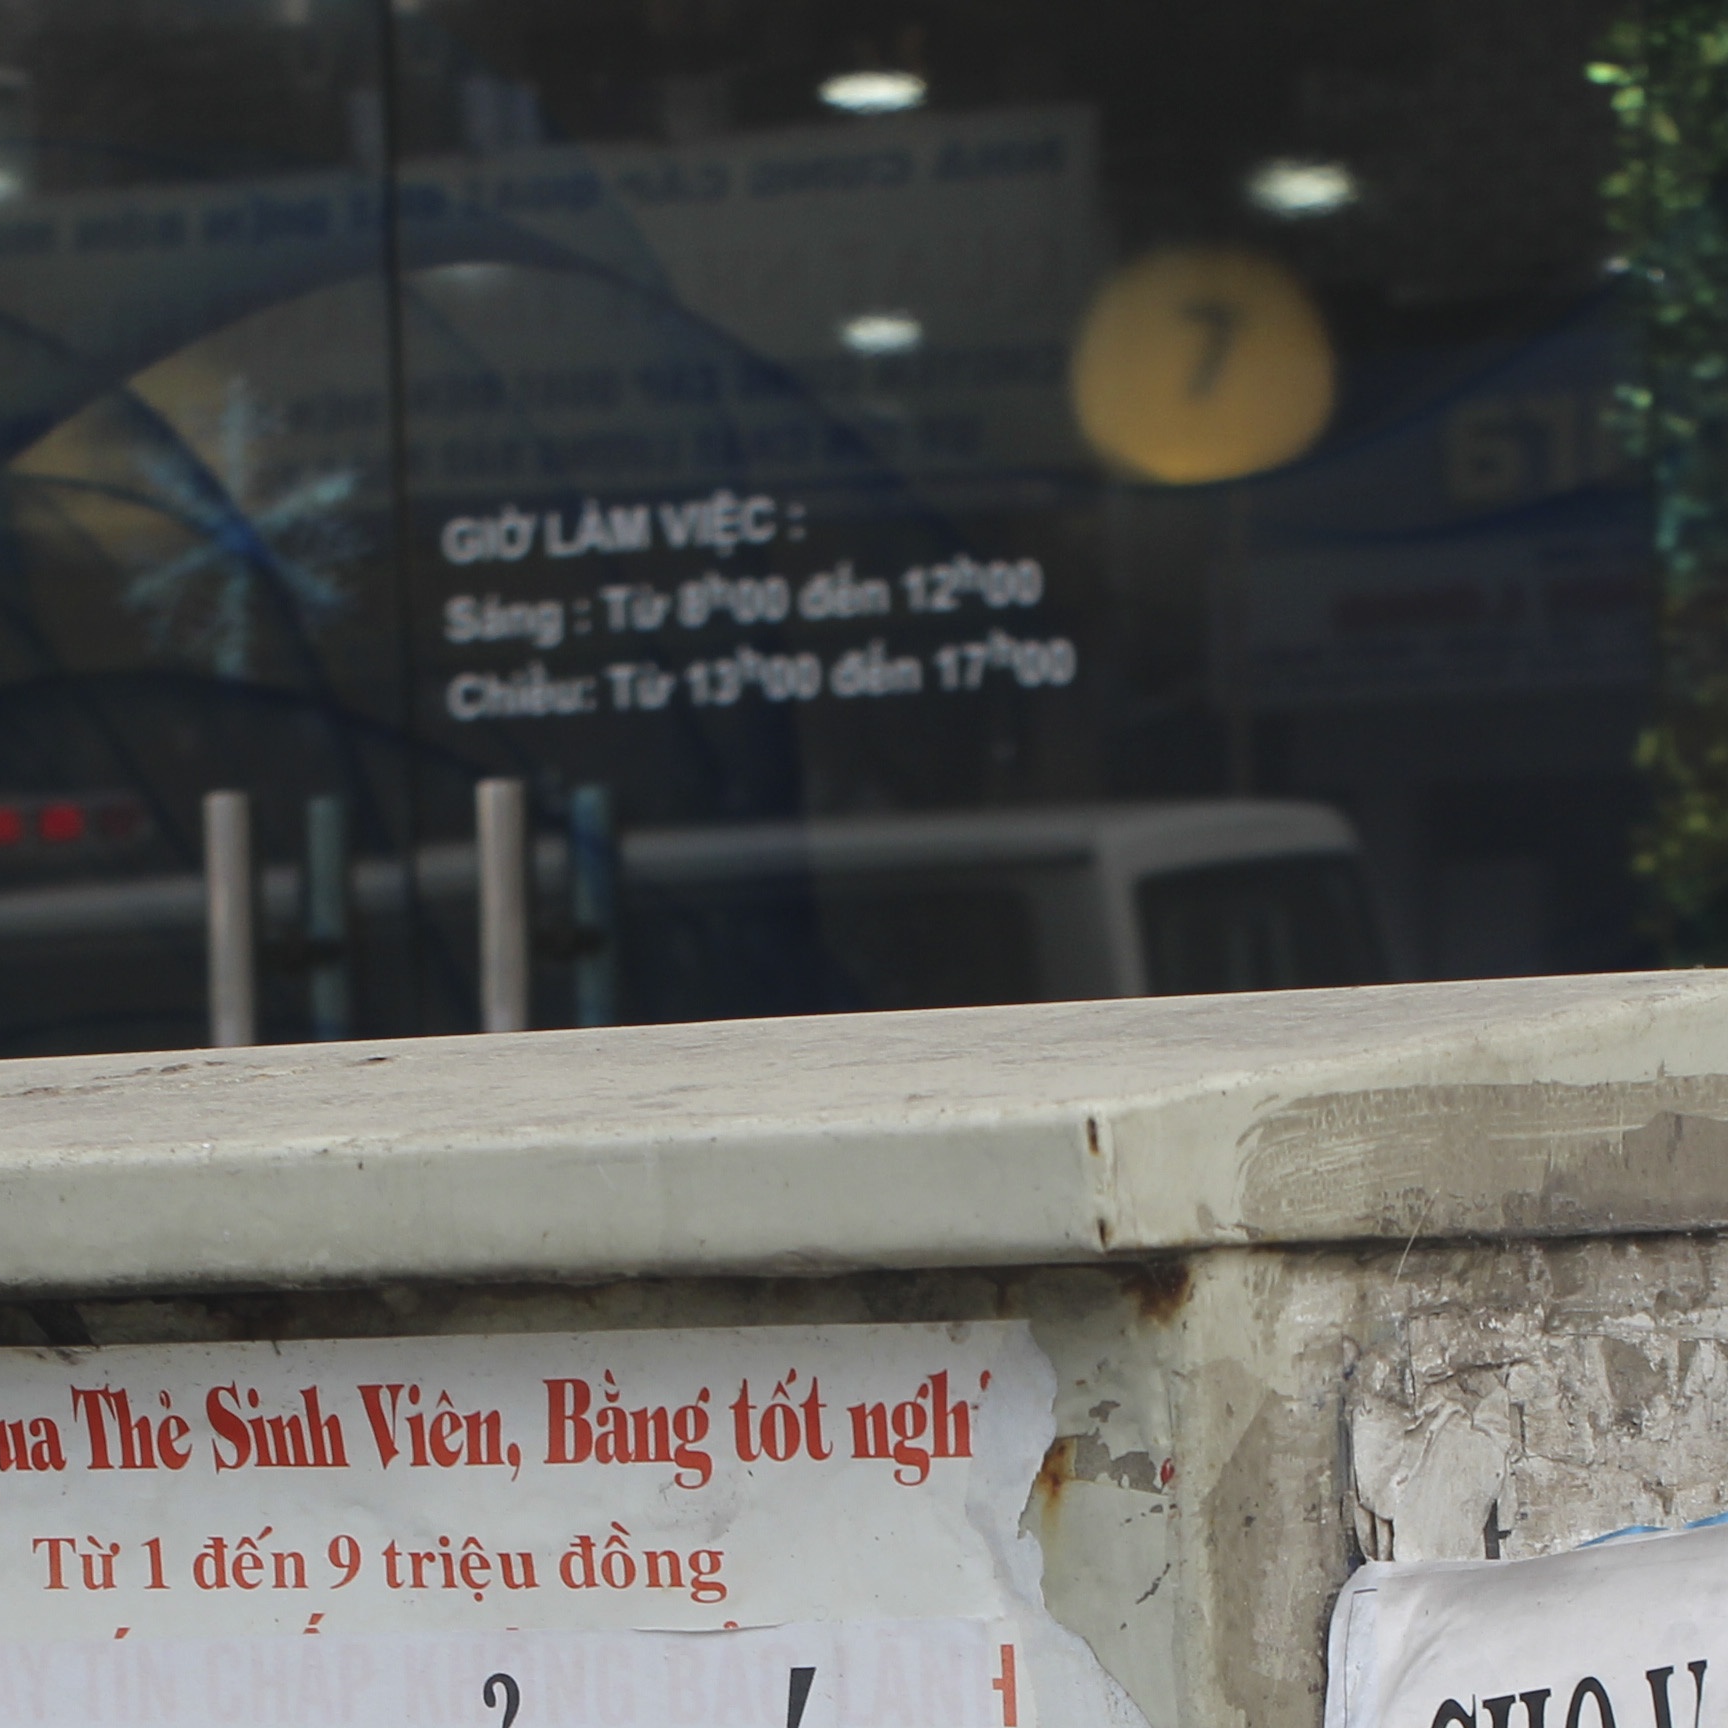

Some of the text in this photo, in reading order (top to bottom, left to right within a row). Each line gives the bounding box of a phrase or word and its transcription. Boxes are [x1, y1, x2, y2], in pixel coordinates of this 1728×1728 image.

[442, 503, 536, 563] GIỜ
[544, 499, 650, 558] LÀM
[658, 490, 775, 558] VIỆC
[444, 595, 564, 648] Sáng
[600, 584, 671, 631] Từ
[798, 560, 891, 619] đến
[605, 661, 672, 709] Từ
[830, 639, 922, 696] đến
[72, 1383, 193, 1471] Thẻ
[204, 1381, 350, 1474] Sinh
[357, 1383, 522, 1482] Viên,
[542, 1369, 712, 1490] Bằng
[729, 1367, 833, 1462] tốt
[32, 1520, 729, 1604] Từ 1 đến 9 triệu đồng
